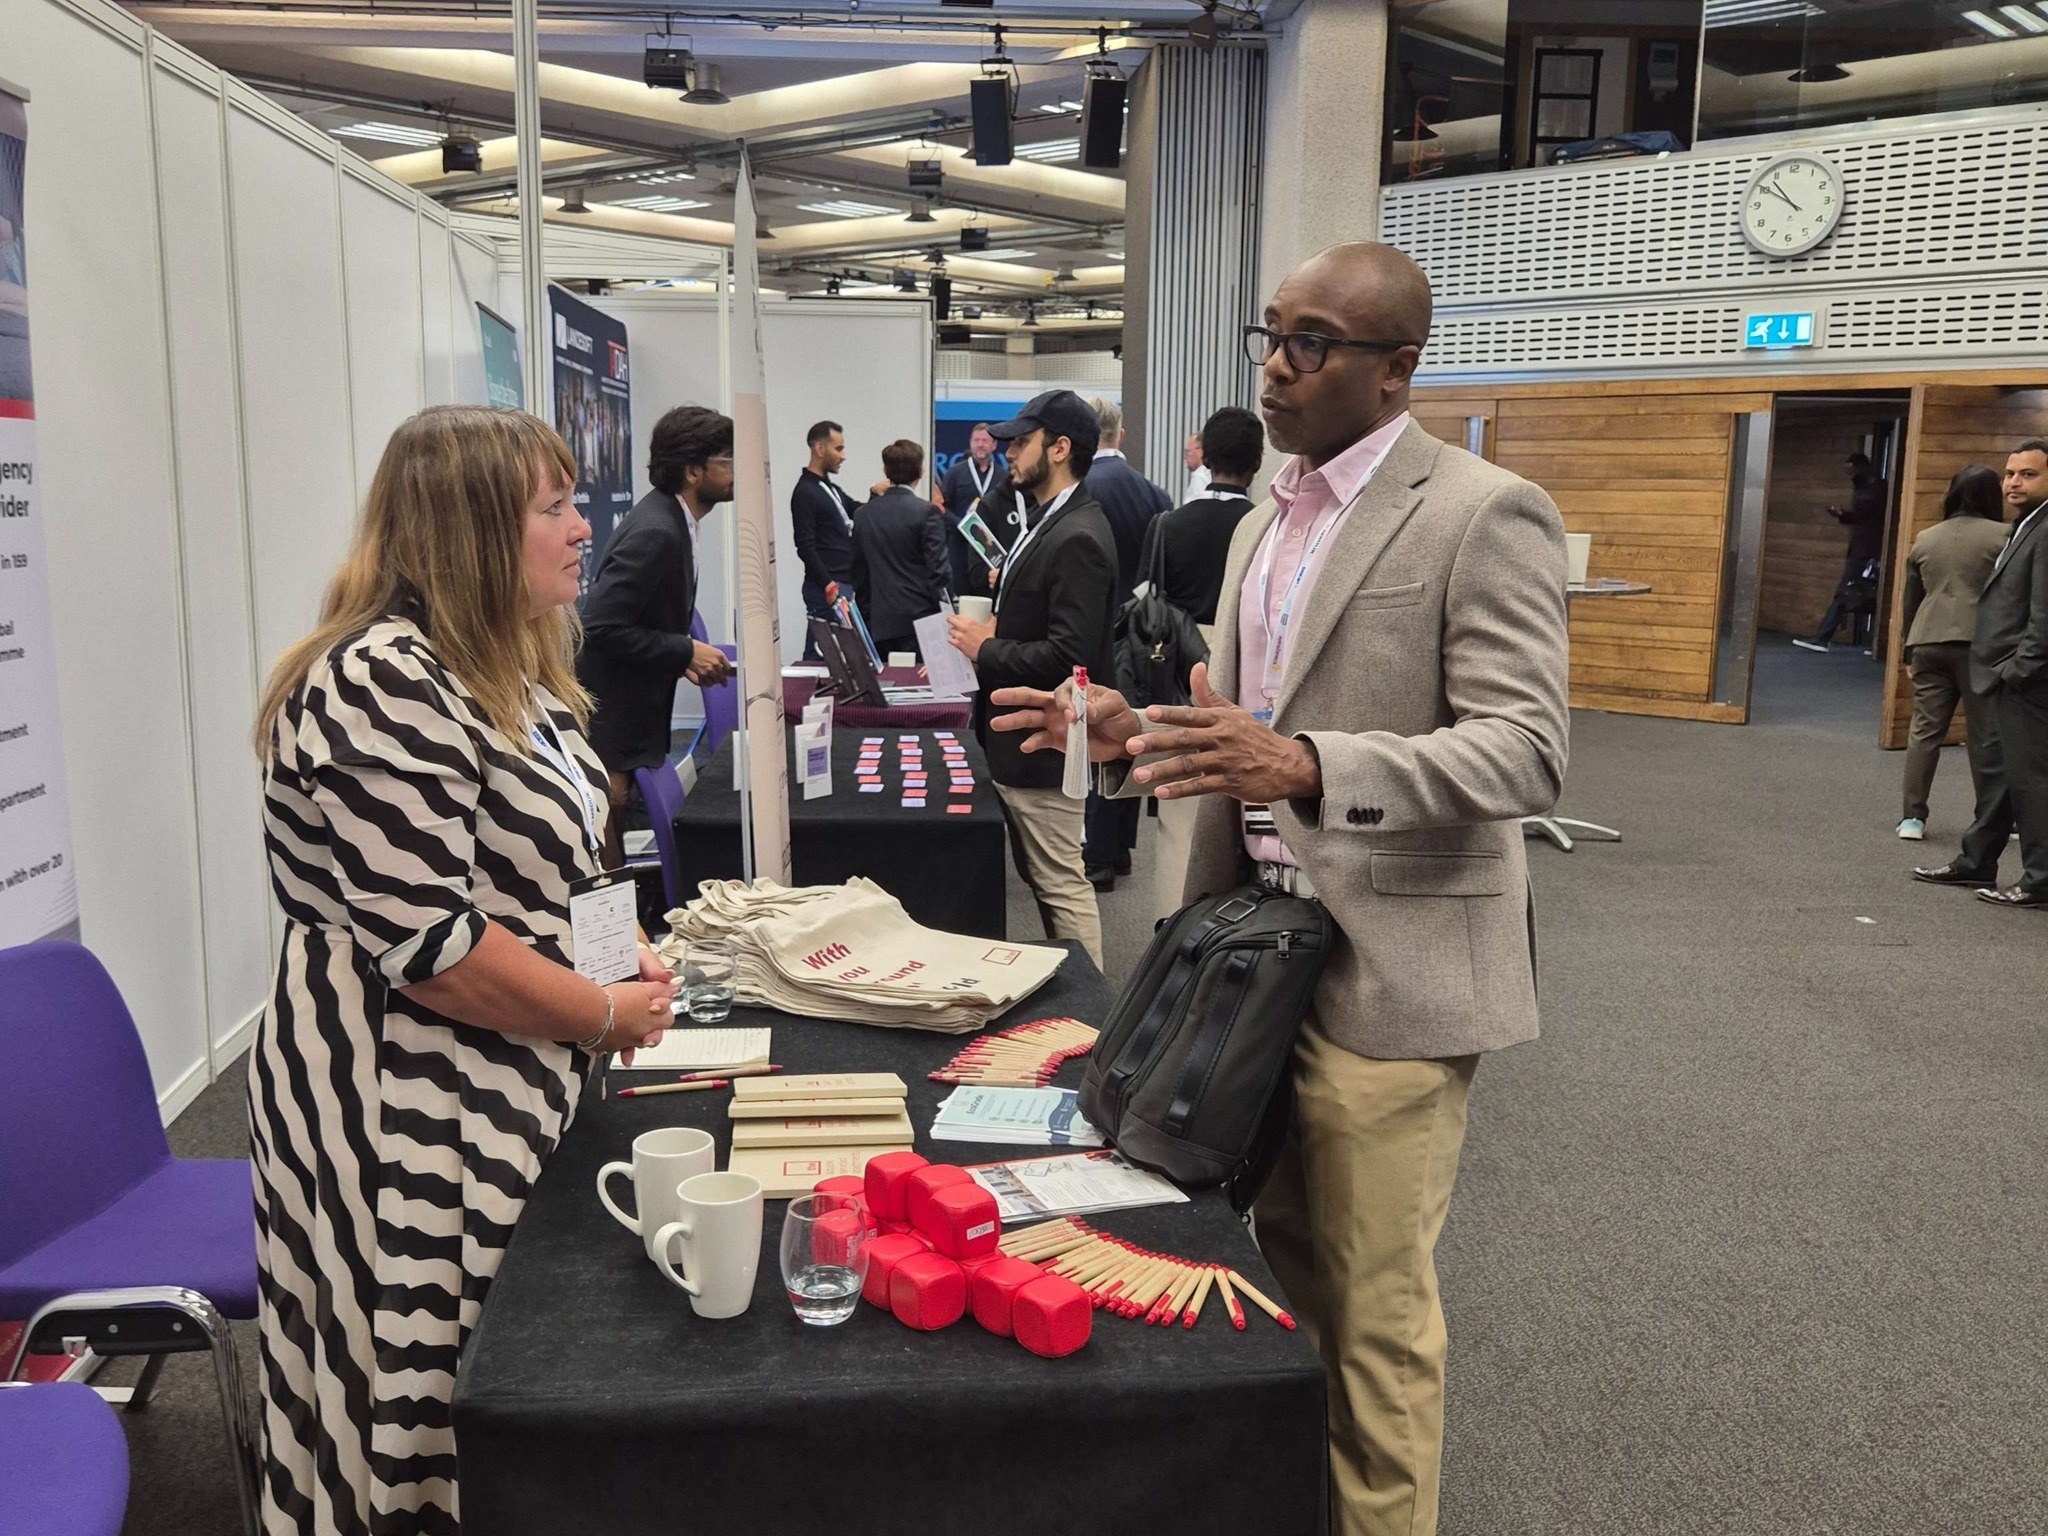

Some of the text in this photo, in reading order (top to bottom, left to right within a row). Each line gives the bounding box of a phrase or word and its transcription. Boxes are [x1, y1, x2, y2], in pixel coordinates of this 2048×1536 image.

[1790, 165, 1800, 173] 12
[1760, 186, 1770, 194] 10
[1824, 197, 1830, 205] 3
[1753, 202, 1761, 210] 9
[1758, 219, 1765, 227] 8
[1815, 215, 1823, 223] 4
[1770, 230, 1777, 238] 7
[1802, 228, 1809, 236] 5
[1784, 234, 1792, 243] 6
[0, 462, 32, 485] ency
[1, 555, 11, 570] in
[7, 868, 28, 889] with
[30, 861, 50, 878] over
[51, 853, 63, 869] 20
[801, 942, 852, 970] With
